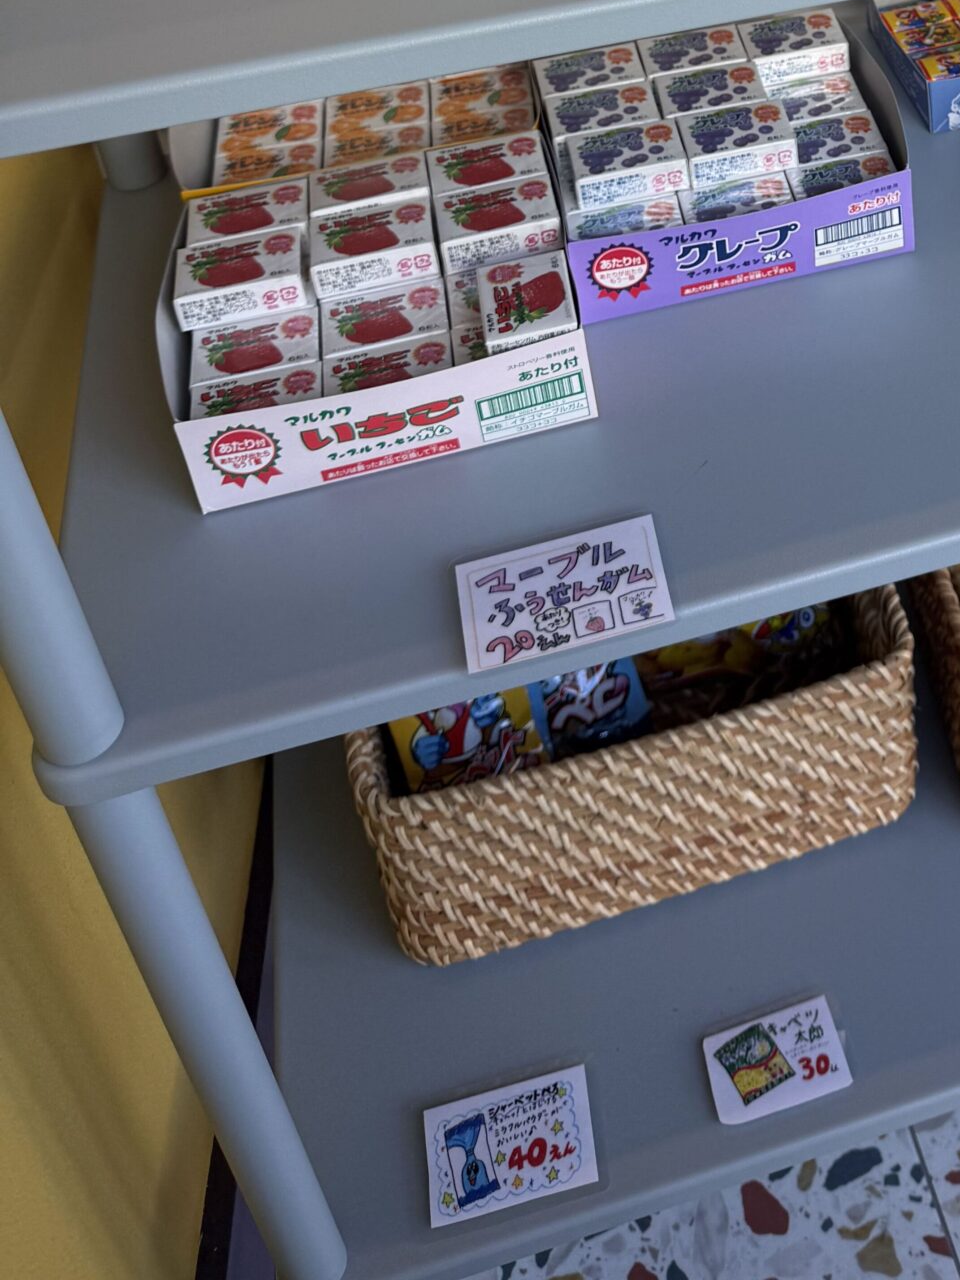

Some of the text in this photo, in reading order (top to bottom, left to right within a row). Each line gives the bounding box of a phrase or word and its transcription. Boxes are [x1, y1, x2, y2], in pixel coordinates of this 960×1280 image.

[848, 191, 901, 216] あたり付
[659, 228, 718, 247] マルカワ
[675, 220, 800, 272] グレープ
[600, 256, 642, 270] あたり付
[518, 356, 579, 382] あたり付
[284, 405, 353, 427] マルカワ
[299, 394, 465, 452] いちご
[218, 438, 267, 455] あたり付
[475, 540, 627, 594] マーブル
[487, 564, 654, 628] ふうせんガム
[767, 1008, 820, 1037] キャベツ
[794, 1023, 825, 1045] 太郎
